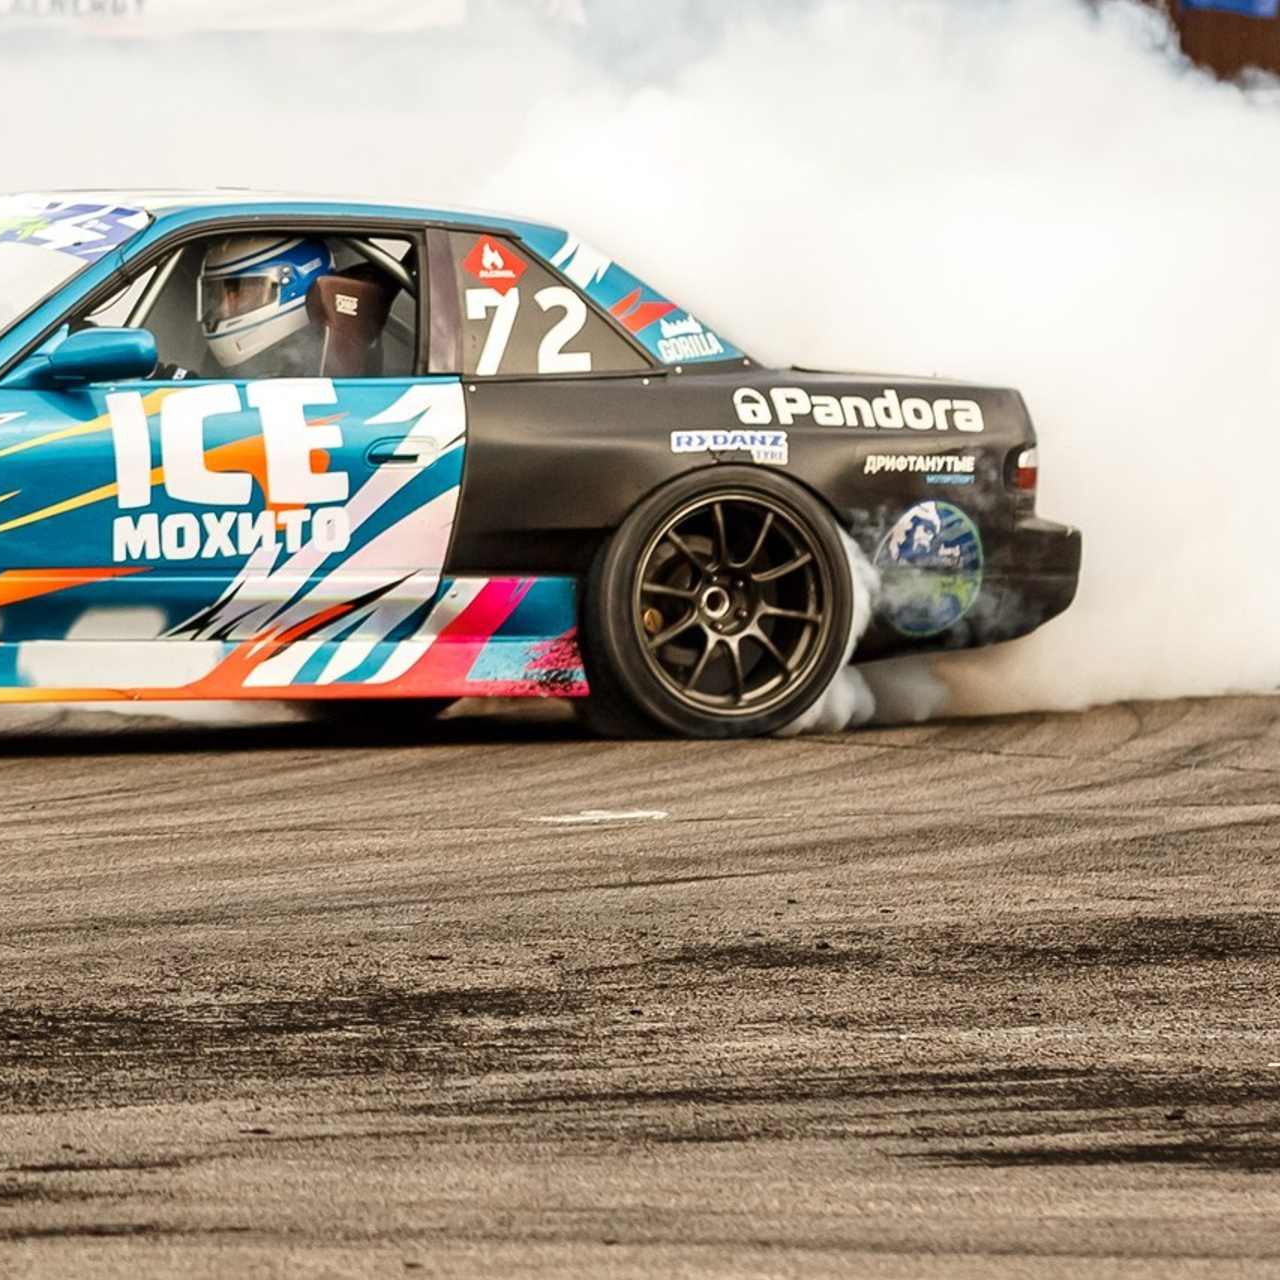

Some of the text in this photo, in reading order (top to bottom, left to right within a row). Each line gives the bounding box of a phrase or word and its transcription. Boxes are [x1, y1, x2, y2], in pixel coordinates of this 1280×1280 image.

[657, 332, 724, 363] GORILLA
[770, 387, 985, 432] Pandora
[106, 378, 350, 509] ICE
[863, 454, 976, 475] ДРИФТАНУТЫЕ
[113, 506, 351, 562] МОХИТО
